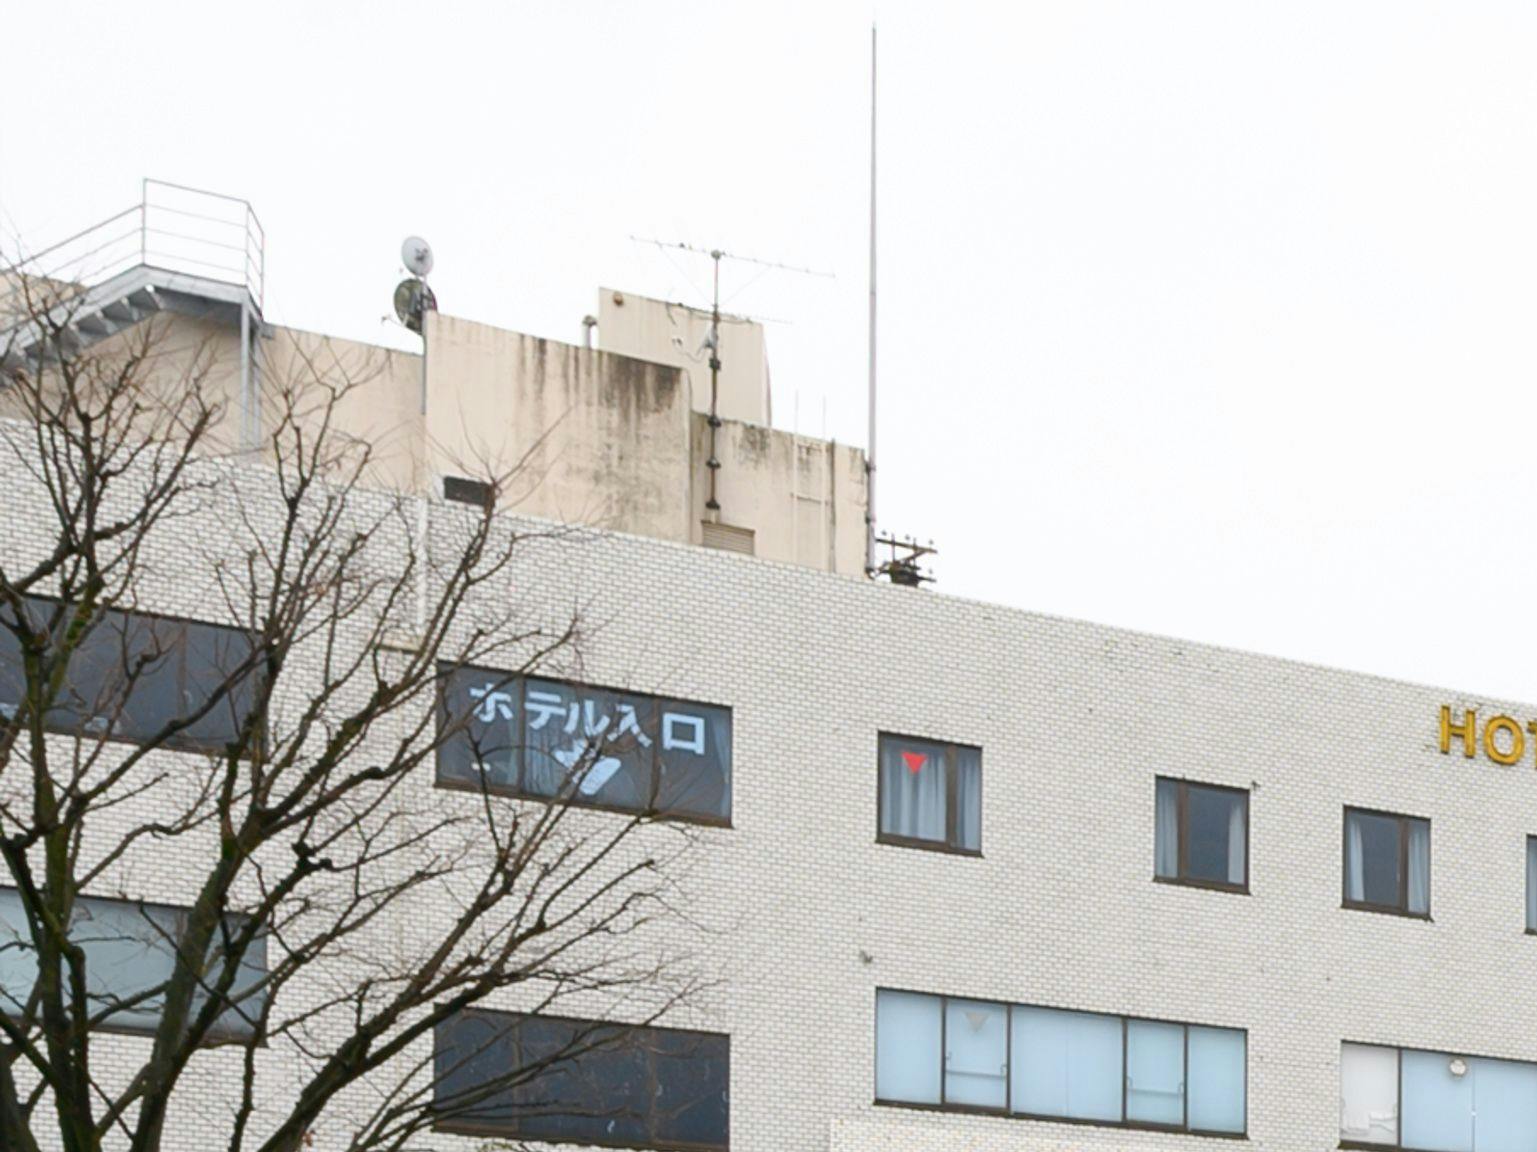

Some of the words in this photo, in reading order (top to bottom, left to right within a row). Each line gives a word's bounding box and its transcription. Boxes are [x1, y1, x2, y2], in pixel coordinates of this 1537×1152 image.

[469, 683, 705, 755] ホテル入口
